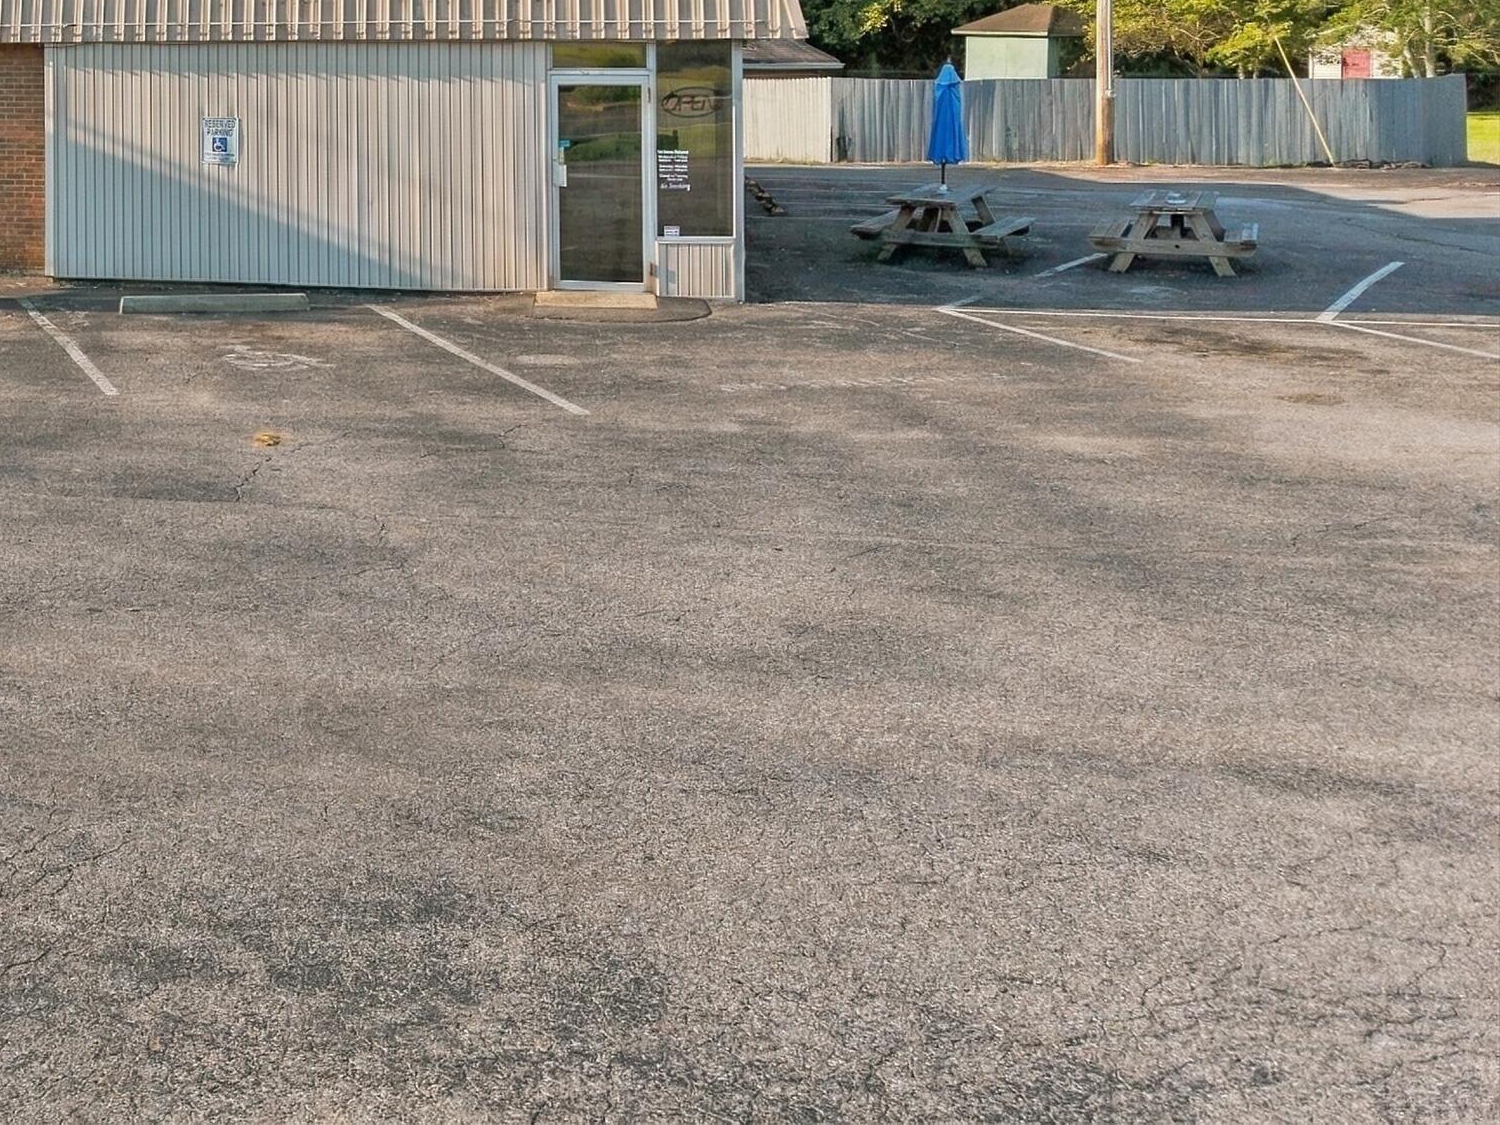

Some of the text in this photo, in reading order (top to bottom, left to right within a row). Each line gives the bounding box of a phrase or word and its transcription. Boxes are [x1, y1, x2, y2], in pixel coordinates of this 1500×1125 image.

[663, 95, 718, 112] OPEN
[204, 119, 236, 129] RESERVED
[206, 128, 234, 137] PARKING
